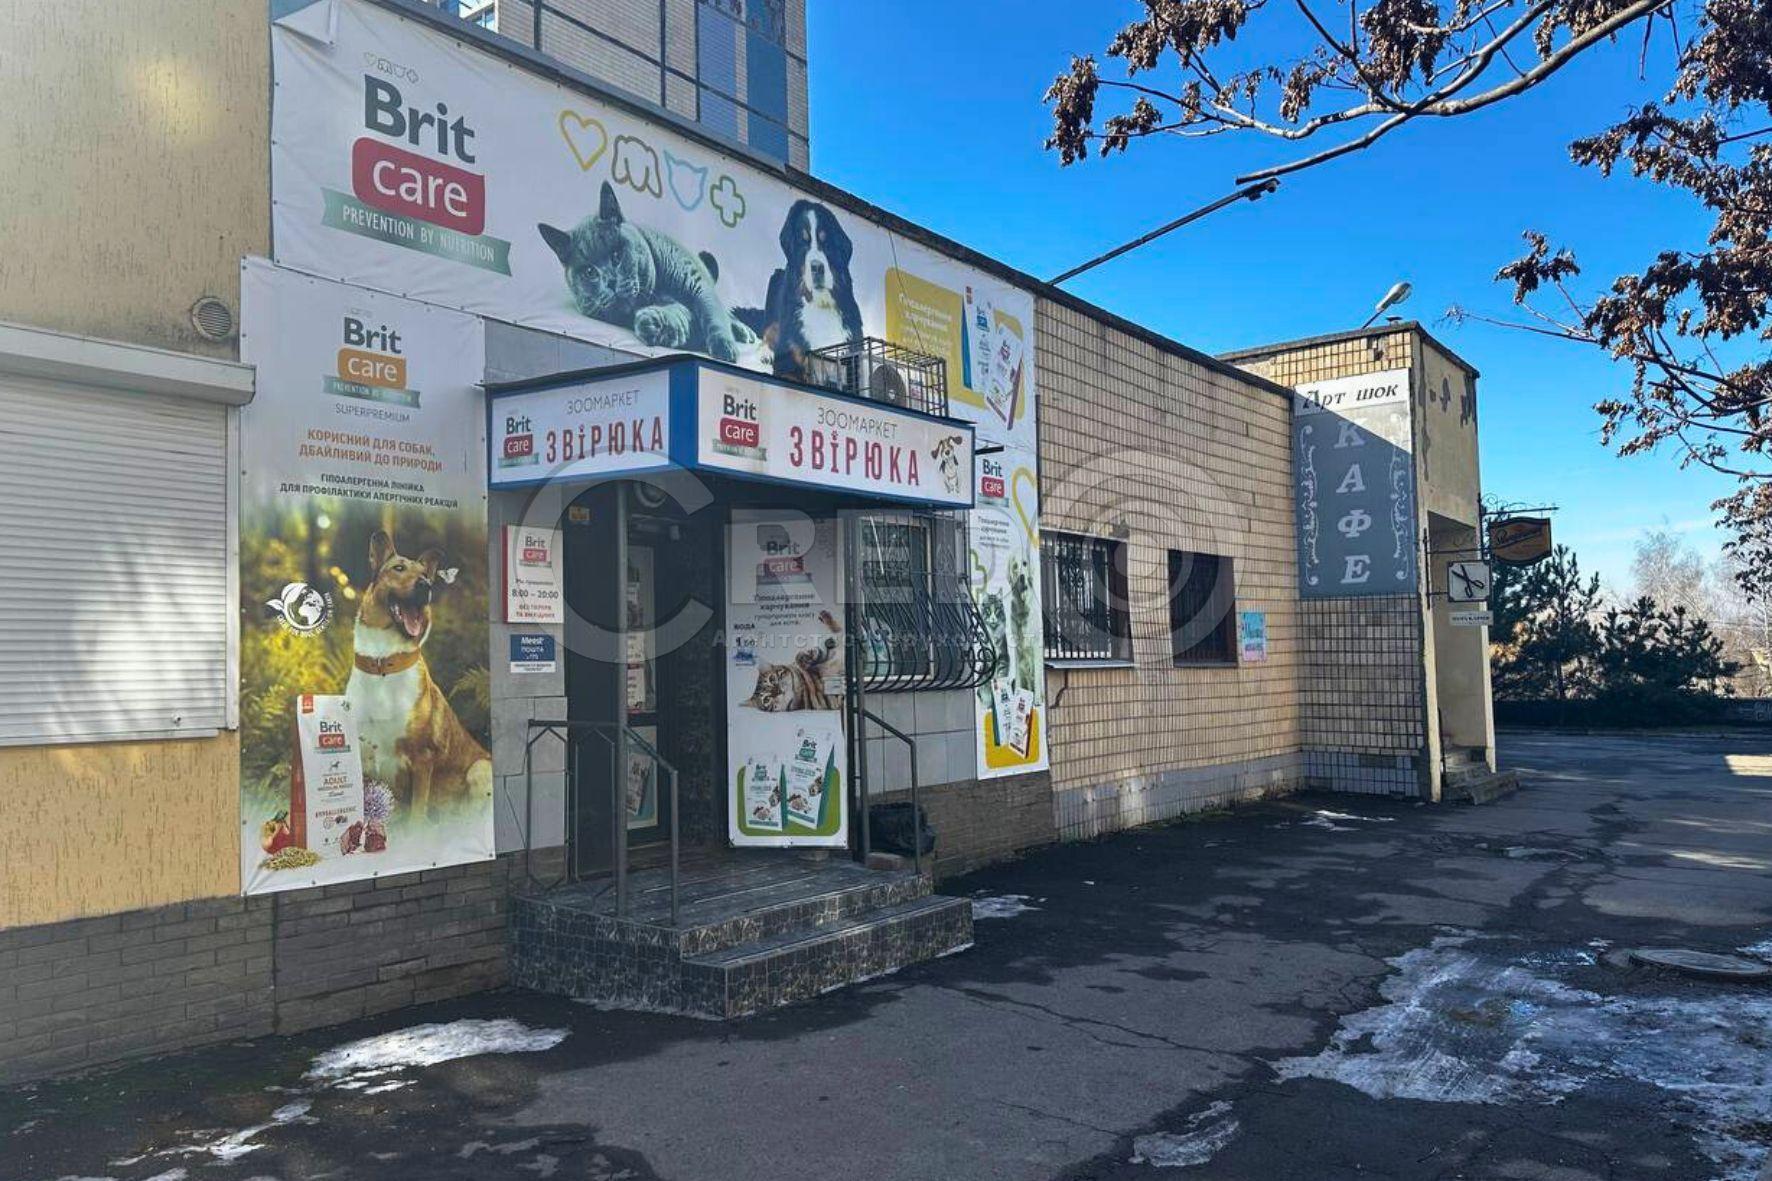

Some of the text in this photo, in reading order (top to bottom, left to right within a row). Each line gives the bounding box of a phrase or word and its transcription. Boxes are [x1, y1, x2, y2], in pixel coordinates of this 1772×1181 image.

[364, 74, 475, 164] Brit
[372, 160, 467, 217] care
[342, 205, 495, 263] PREVENTION BY NUTRITION
[344, 316, 402, 354] Brit
[347, 357, 398, 382] care
[567, 389, 640, 415] ЗООМАРКЕТ
[724, 393, 757, 420] Brit
[335, 403, 410, 422] SUPERPREMIUM
[506, 416, 531, 434] Brit
[725, 424, 755, 442] care
[817, 407, 898, 439] ЗООМАРКЕТ
[308, 428, 370, 446] КОРИСНИЙ
[373, 437, 396, 450] ДЛЯ
[507, 438, 530, 453] care
[299, 444, 443, 473] ДБАЙЛИВИЙ ДО ПРИРОДИ
[982, 458, 1003, 477] Brit
[280, 483, 300, 493] ДЛЯ
[302, 484, 372, 499] ПРОФІЛАКТИКИ
[984, 481, 1002, 494] care
[1334, 417, 1372, 584] КАФЕ
[525, 535, 545, 548] Brit
[767, 541, 801, 555] Brit
[768, 561, 800, 573] care
[320, 720, 343, 733] Brit
